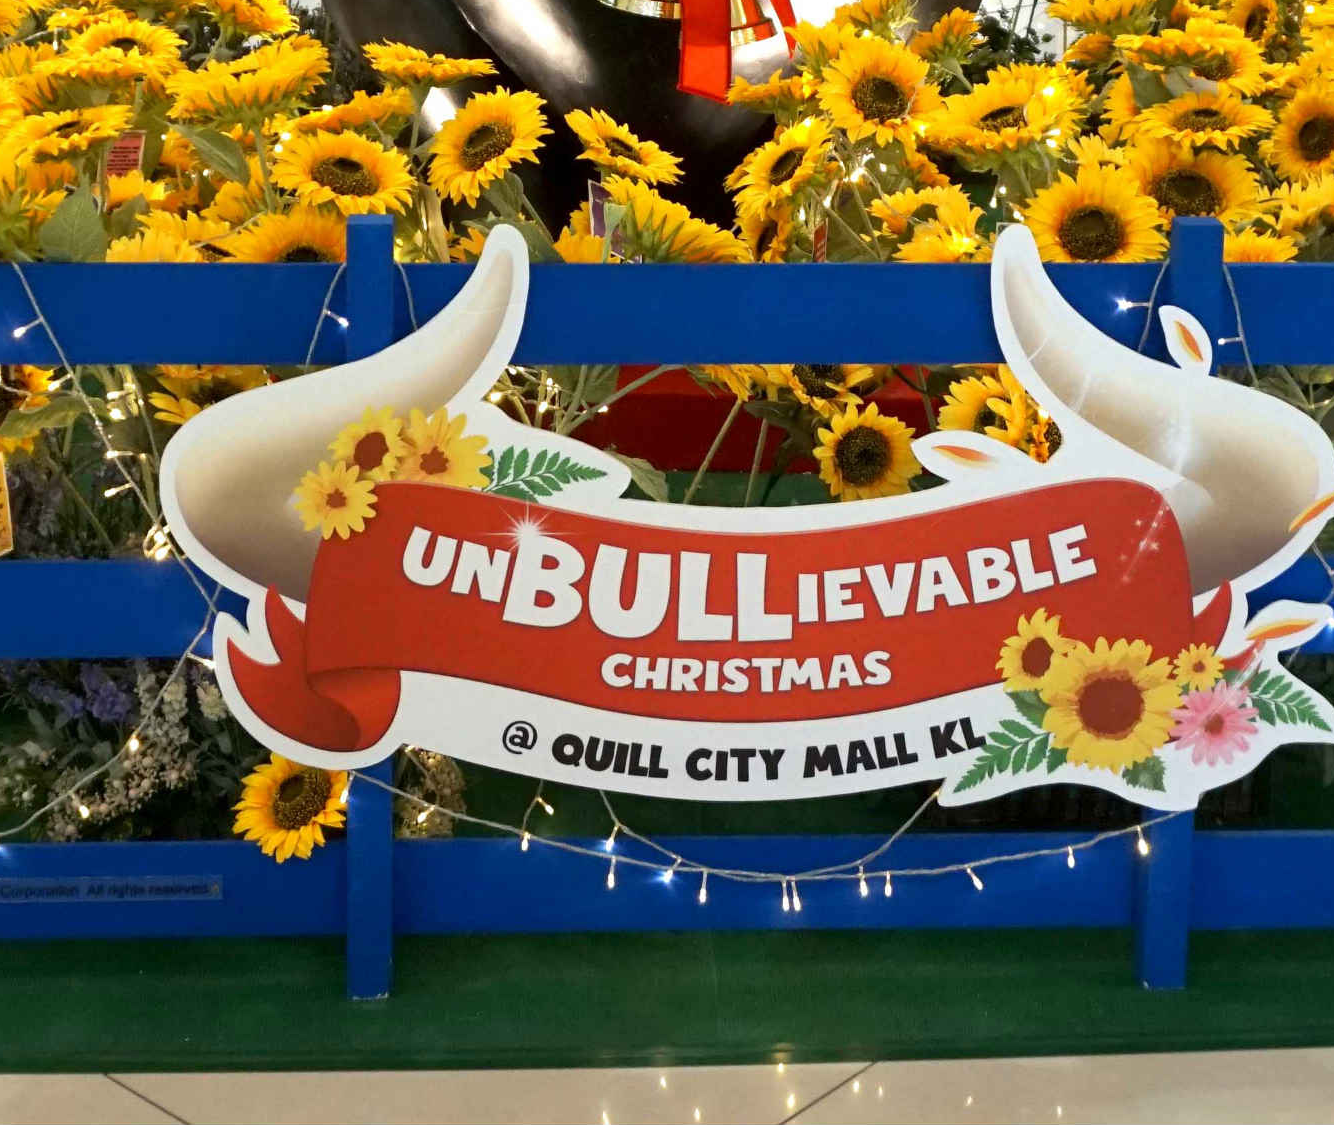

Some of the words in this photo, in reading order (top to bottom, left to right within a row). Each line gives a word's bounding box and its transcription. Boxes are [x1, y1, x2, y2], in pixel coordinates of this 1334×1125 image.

[601, 650, 892, 694] CHRISTMAS
[502, 720, 538, 755] @
[552, 733, 669, 779] QUILL
[685, 747, 786, 782] CITY
[803, 732, 919, 779] MALL
[929, 716, 987, 759] KL
